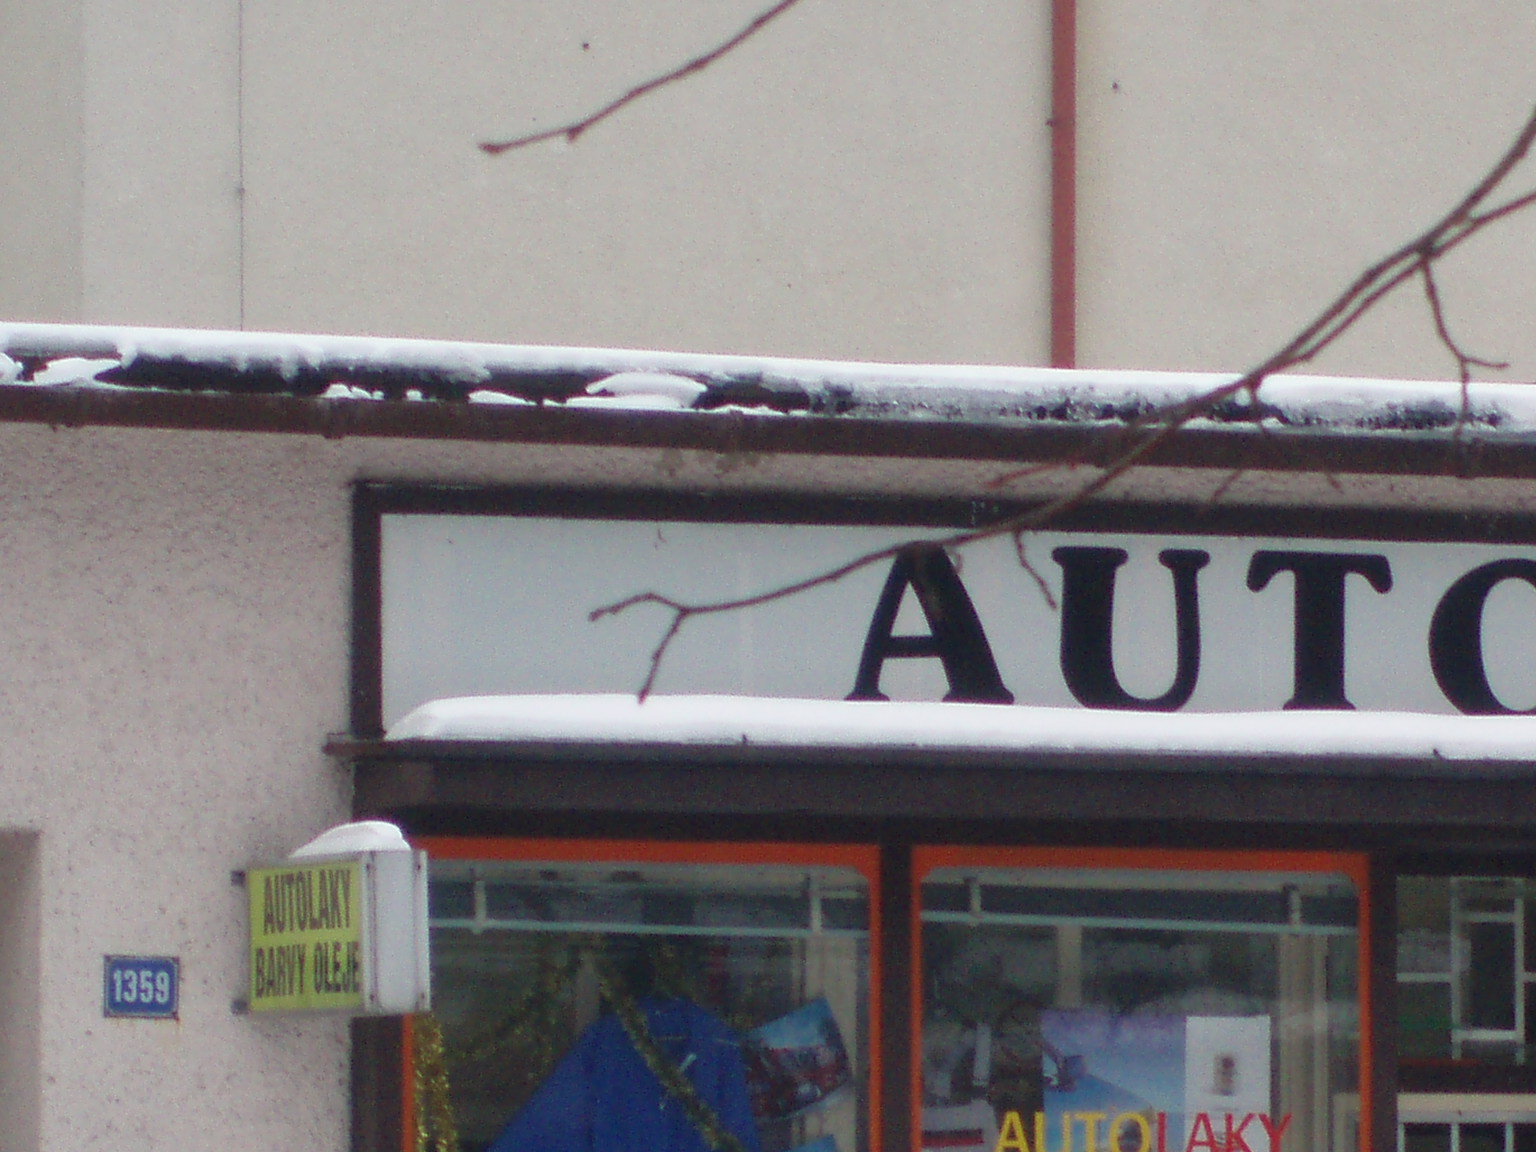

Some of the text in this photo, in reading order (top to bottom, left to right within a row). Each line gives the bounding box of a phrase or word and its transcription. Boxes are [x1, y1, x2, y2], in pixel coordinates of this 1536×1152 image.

[263, 868, 351, 935] AUTOLAKY
[113, 968, 170, 1004] 1359
[255, 940, 360, 998] BARVY OLEJE
